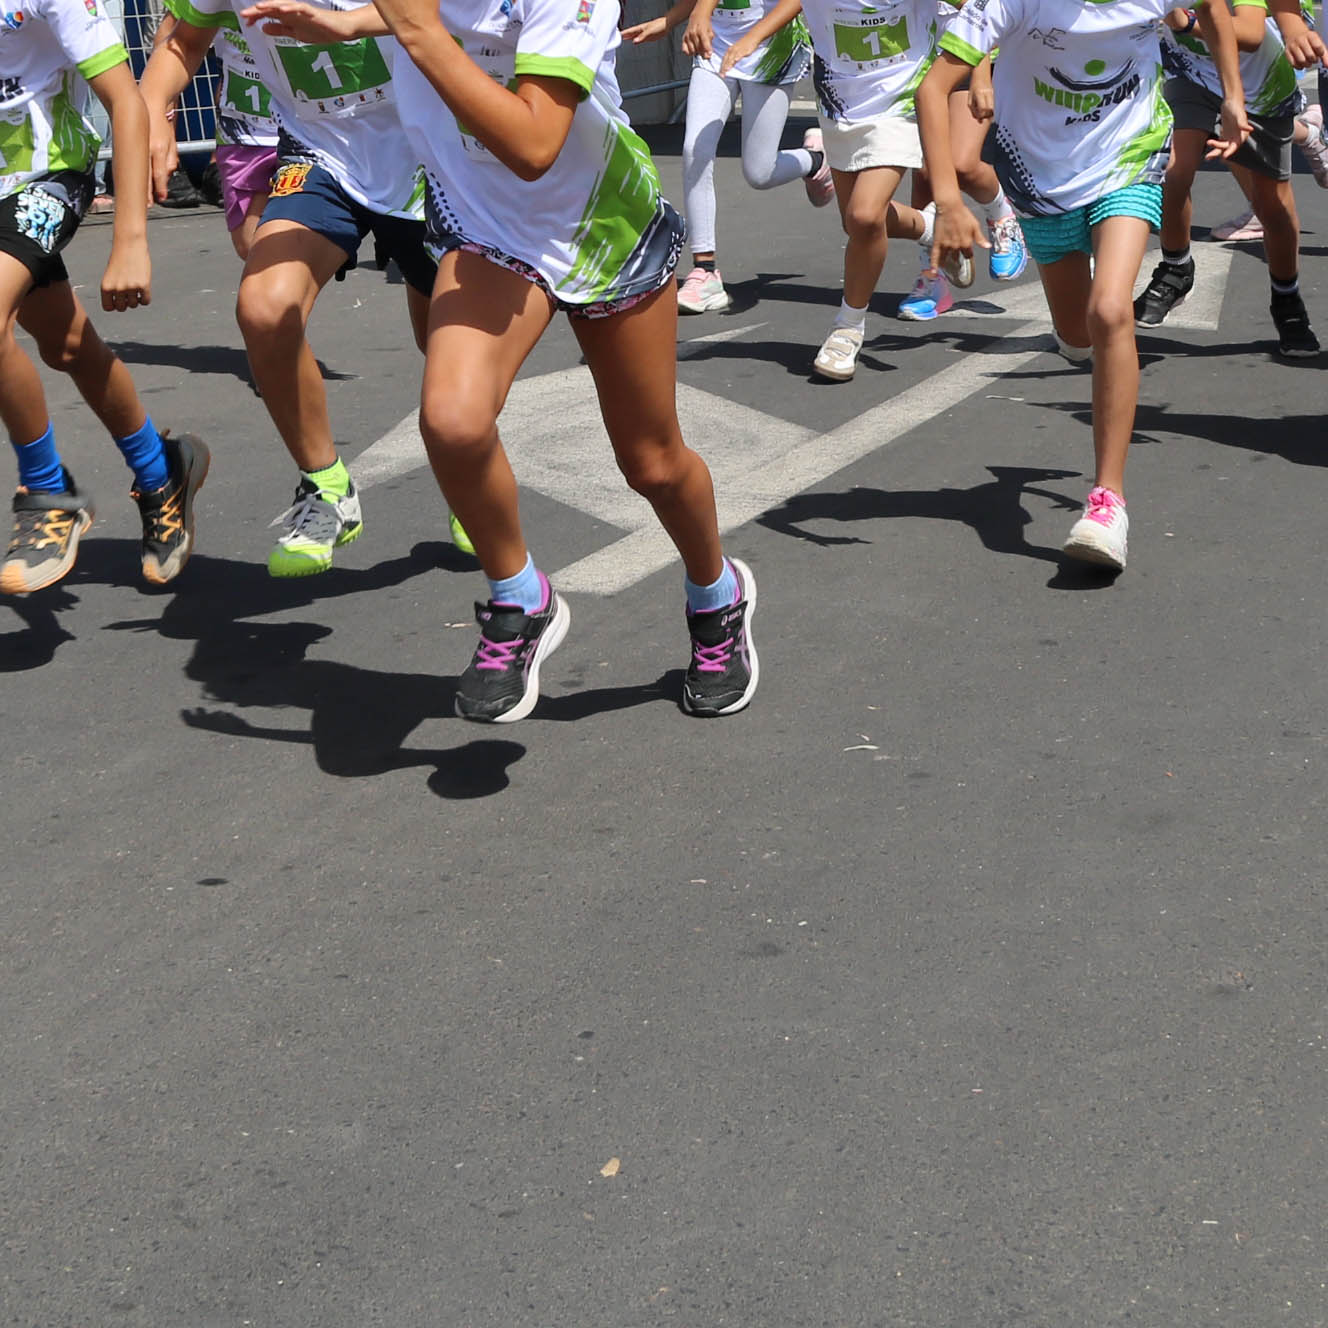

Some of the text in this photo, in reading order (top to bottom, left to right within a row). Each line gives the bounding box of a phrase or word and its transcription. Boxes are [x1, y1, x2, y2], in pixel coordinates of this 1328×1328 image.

[861, 16, 886, 26] KIDS
[862, 32, 881, 56] 1
[244, 70, 260, 80] KID
[311, 51, 344, 89] 1
[245, 85, 260, 112] 1
